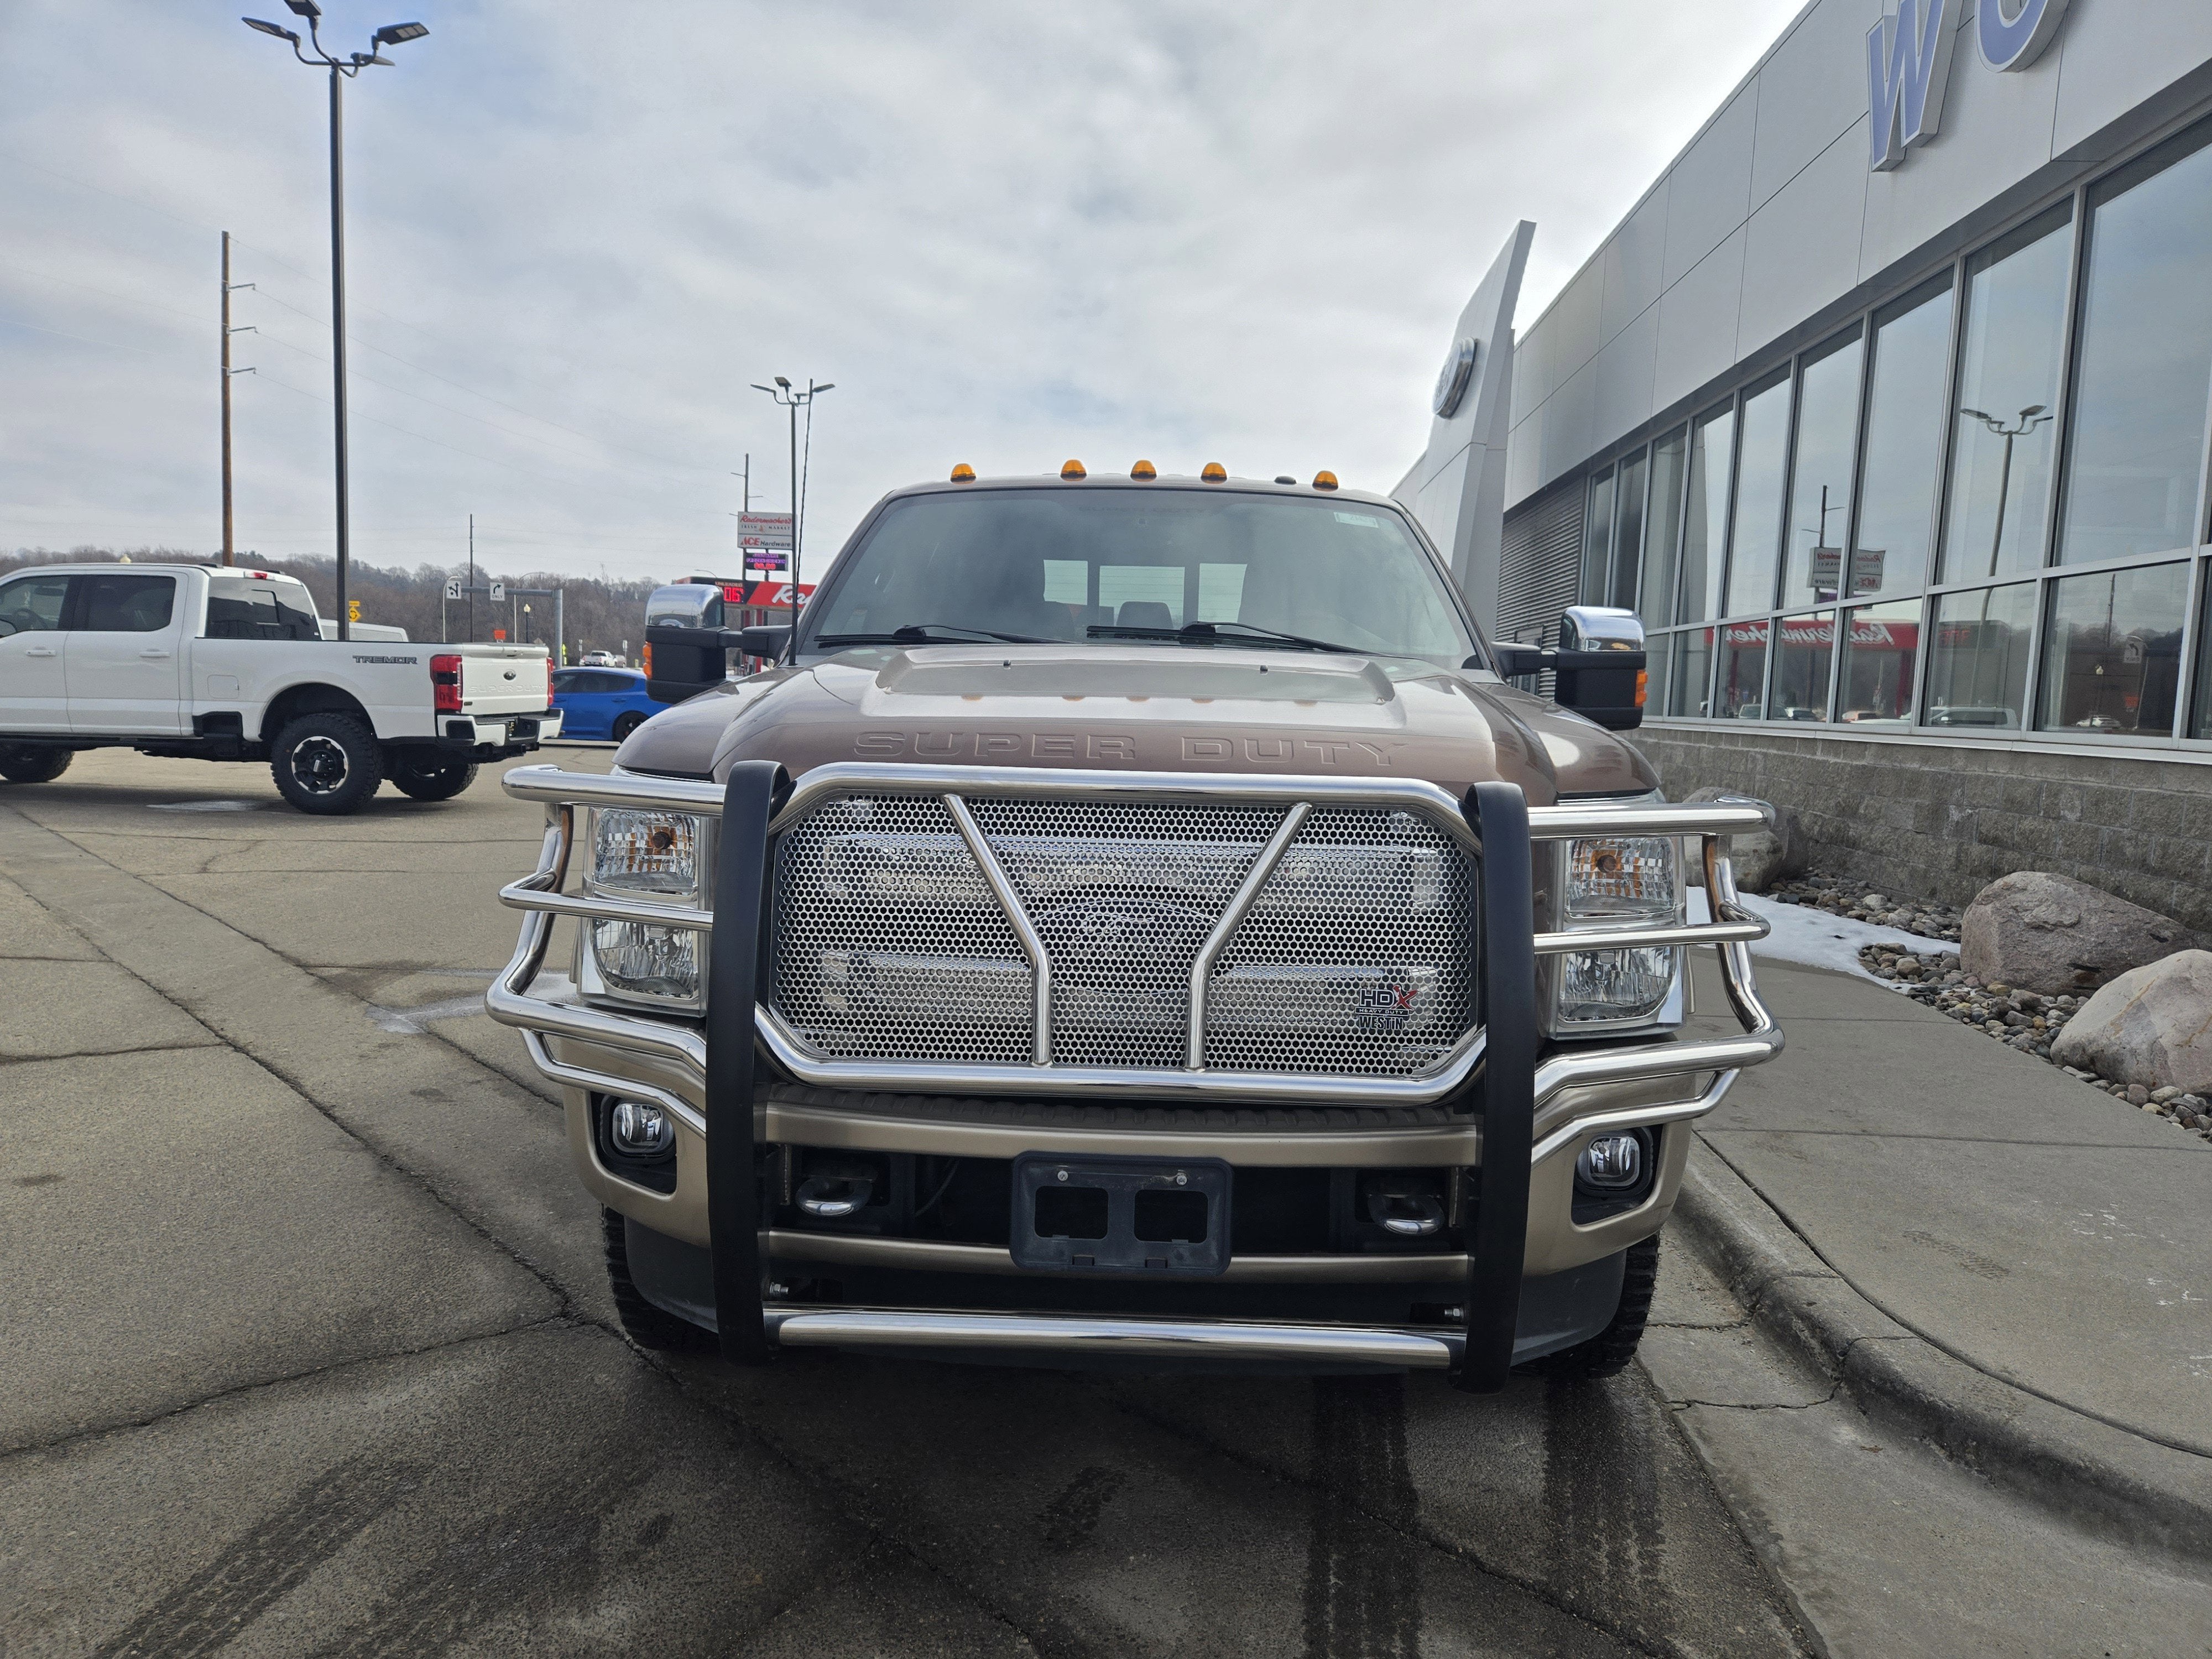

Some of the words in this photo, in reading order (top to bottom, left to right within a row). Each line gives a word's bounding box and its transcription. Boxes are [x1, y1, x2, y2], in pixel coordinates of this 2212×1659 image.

[740, 536, 760, 546] ACE
[352, 655, 418, 664] TREMOR
[469, 685, 513, 693] SUPER
[854, 731, 1136, 760] SUPER
[1181, 736, 1409, 766] DUTY
[1359, 984, 1418, 1010] HDX
